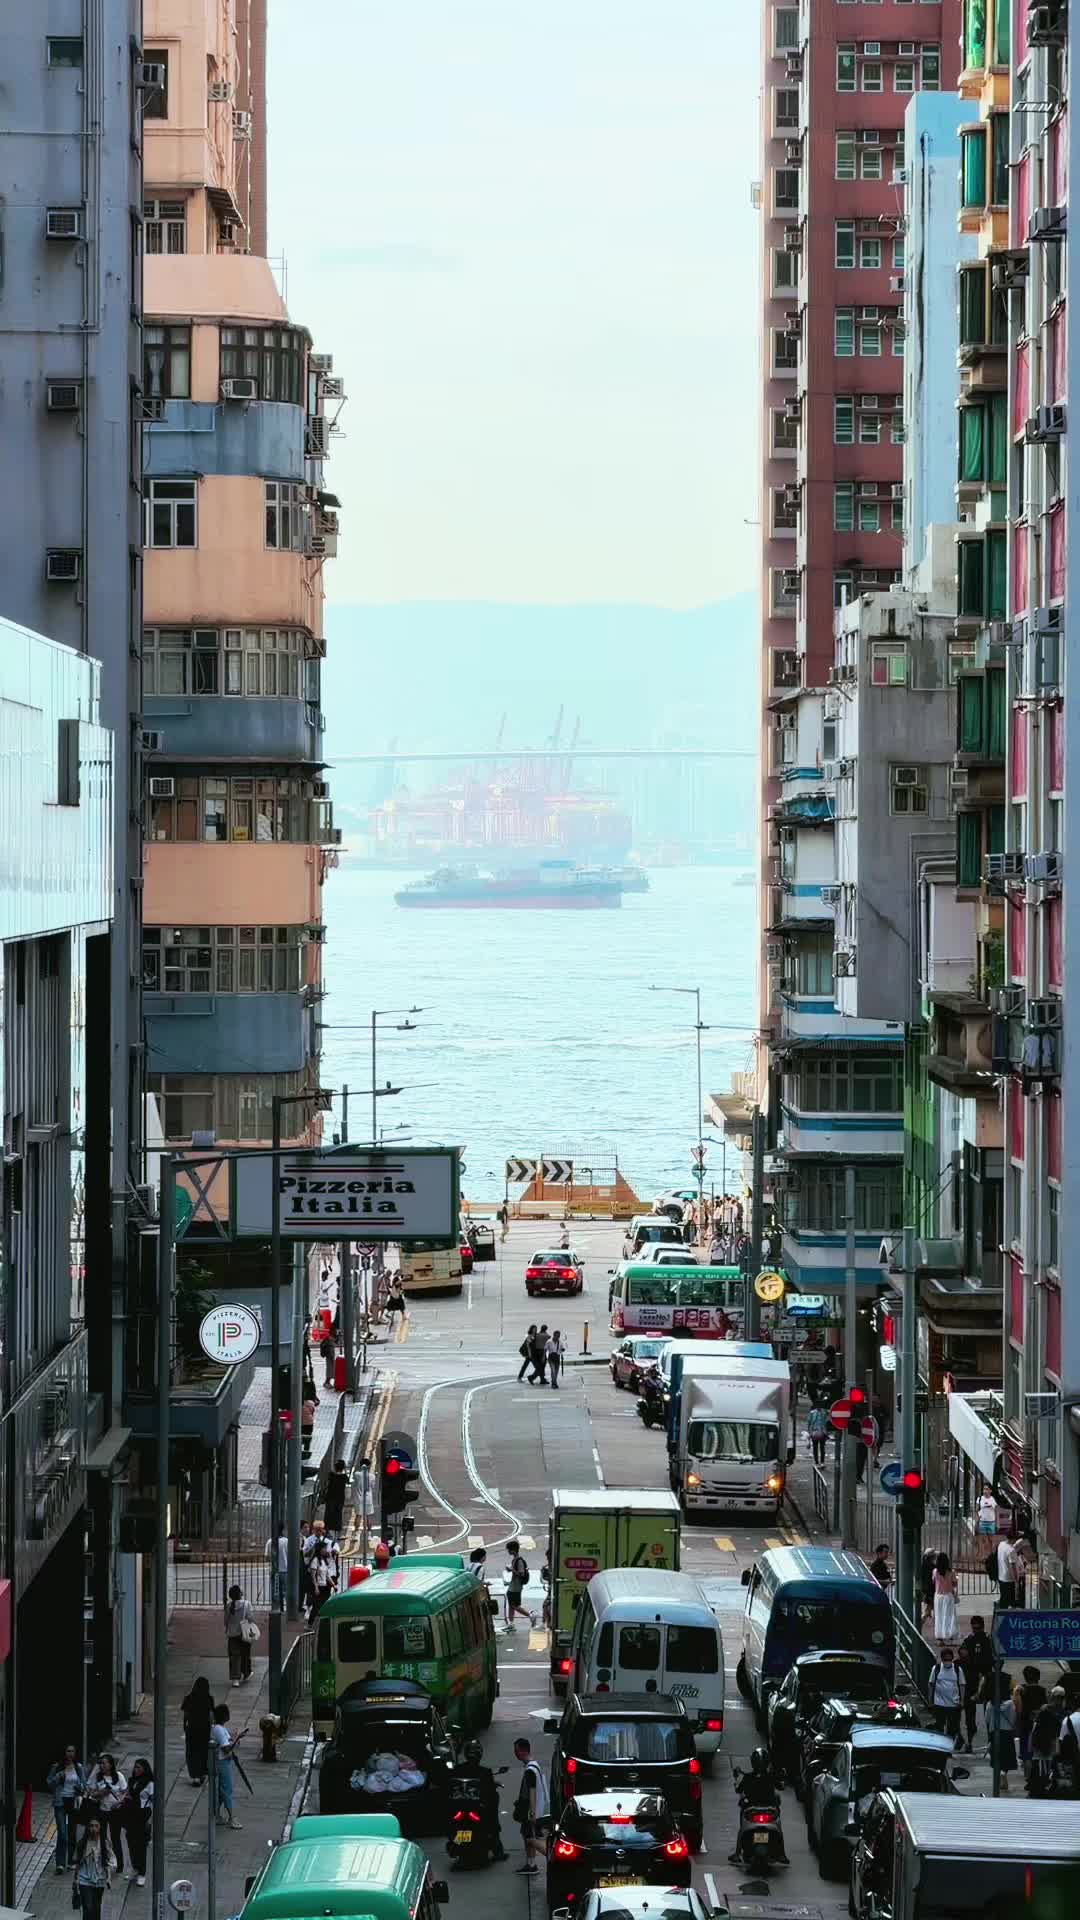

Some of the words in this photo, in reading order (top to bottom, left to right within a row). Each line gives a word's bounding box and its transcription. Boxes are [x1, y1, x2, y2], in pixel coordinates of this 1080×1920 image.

[279, 1176, 415, 1194] Pizzeria
[291, 1196, 398, 1213] Italia
[1008, 1617, 1059, 1629] Victoria
